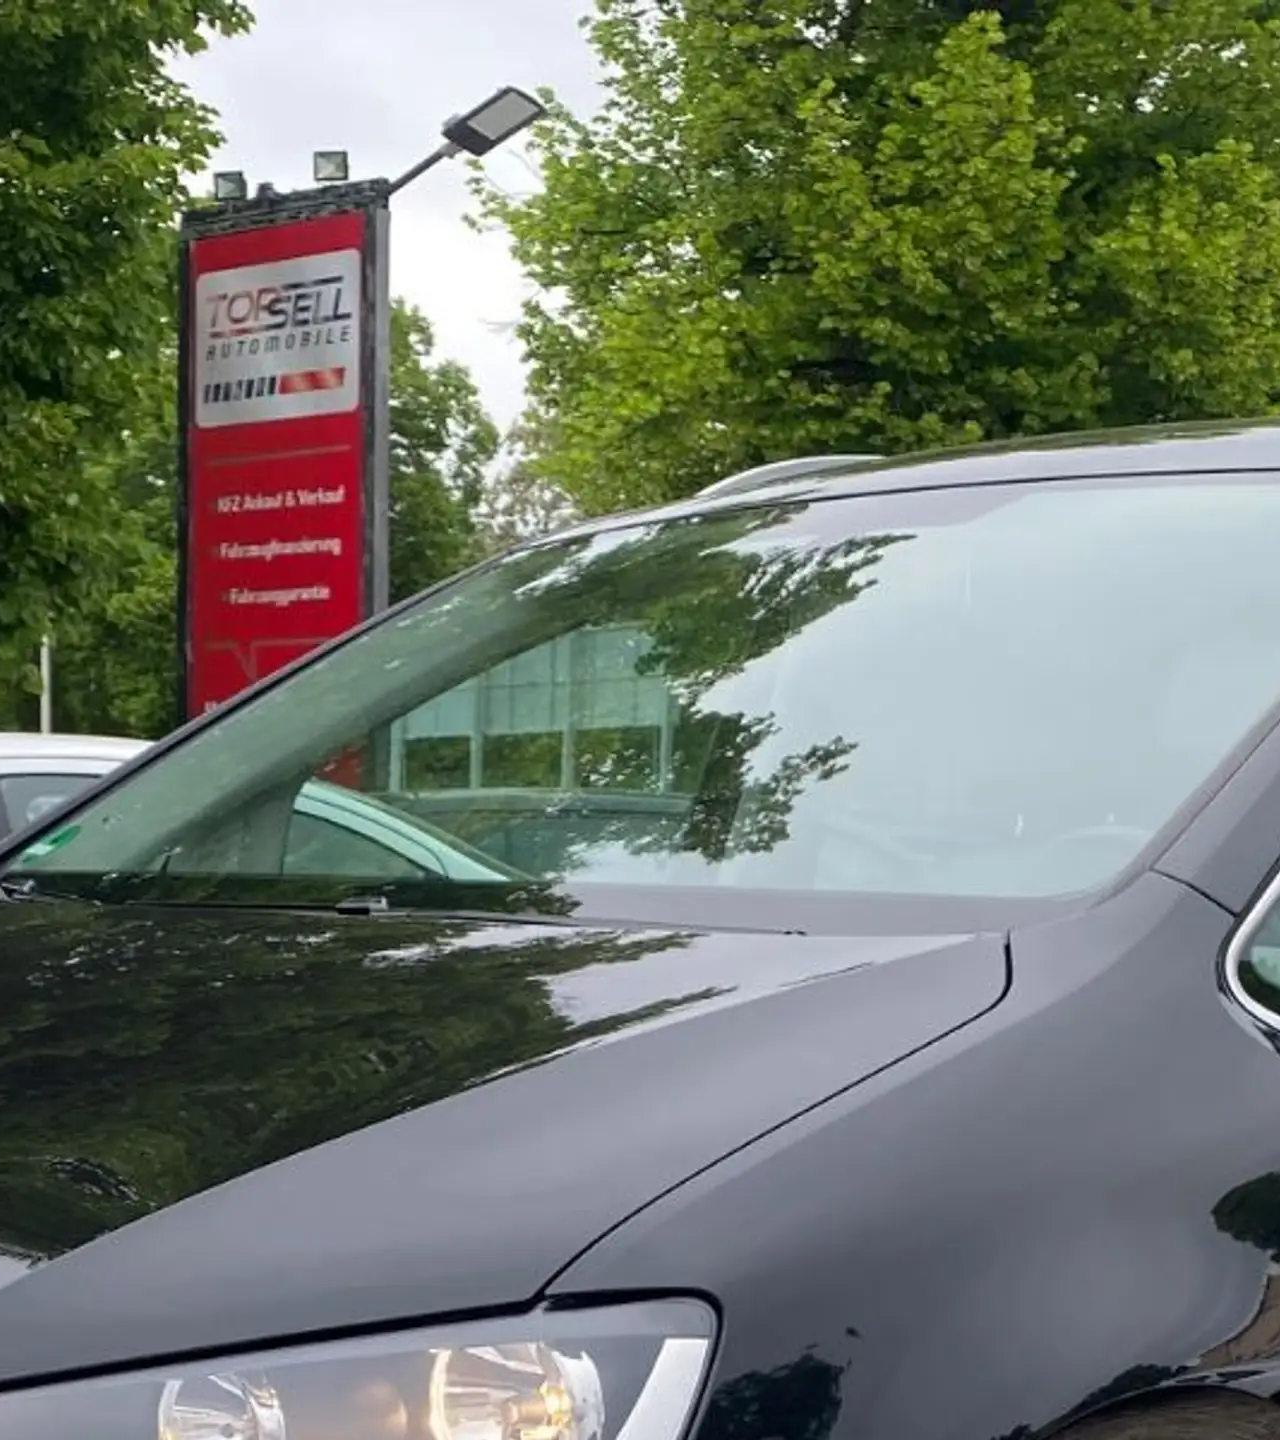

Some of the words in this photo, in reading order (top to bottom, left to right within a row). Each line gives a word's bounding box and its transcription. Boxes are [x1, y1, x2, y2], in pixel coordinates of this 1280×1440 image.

[205, 286, 352, 331] TOPSELL
[206, 323, 352, 361] AUTOMOBILE
[217, 493, 241, 513] KFZ
[284, 489, 296, 507] &
[297, 484, 346, 506] Verkauf
